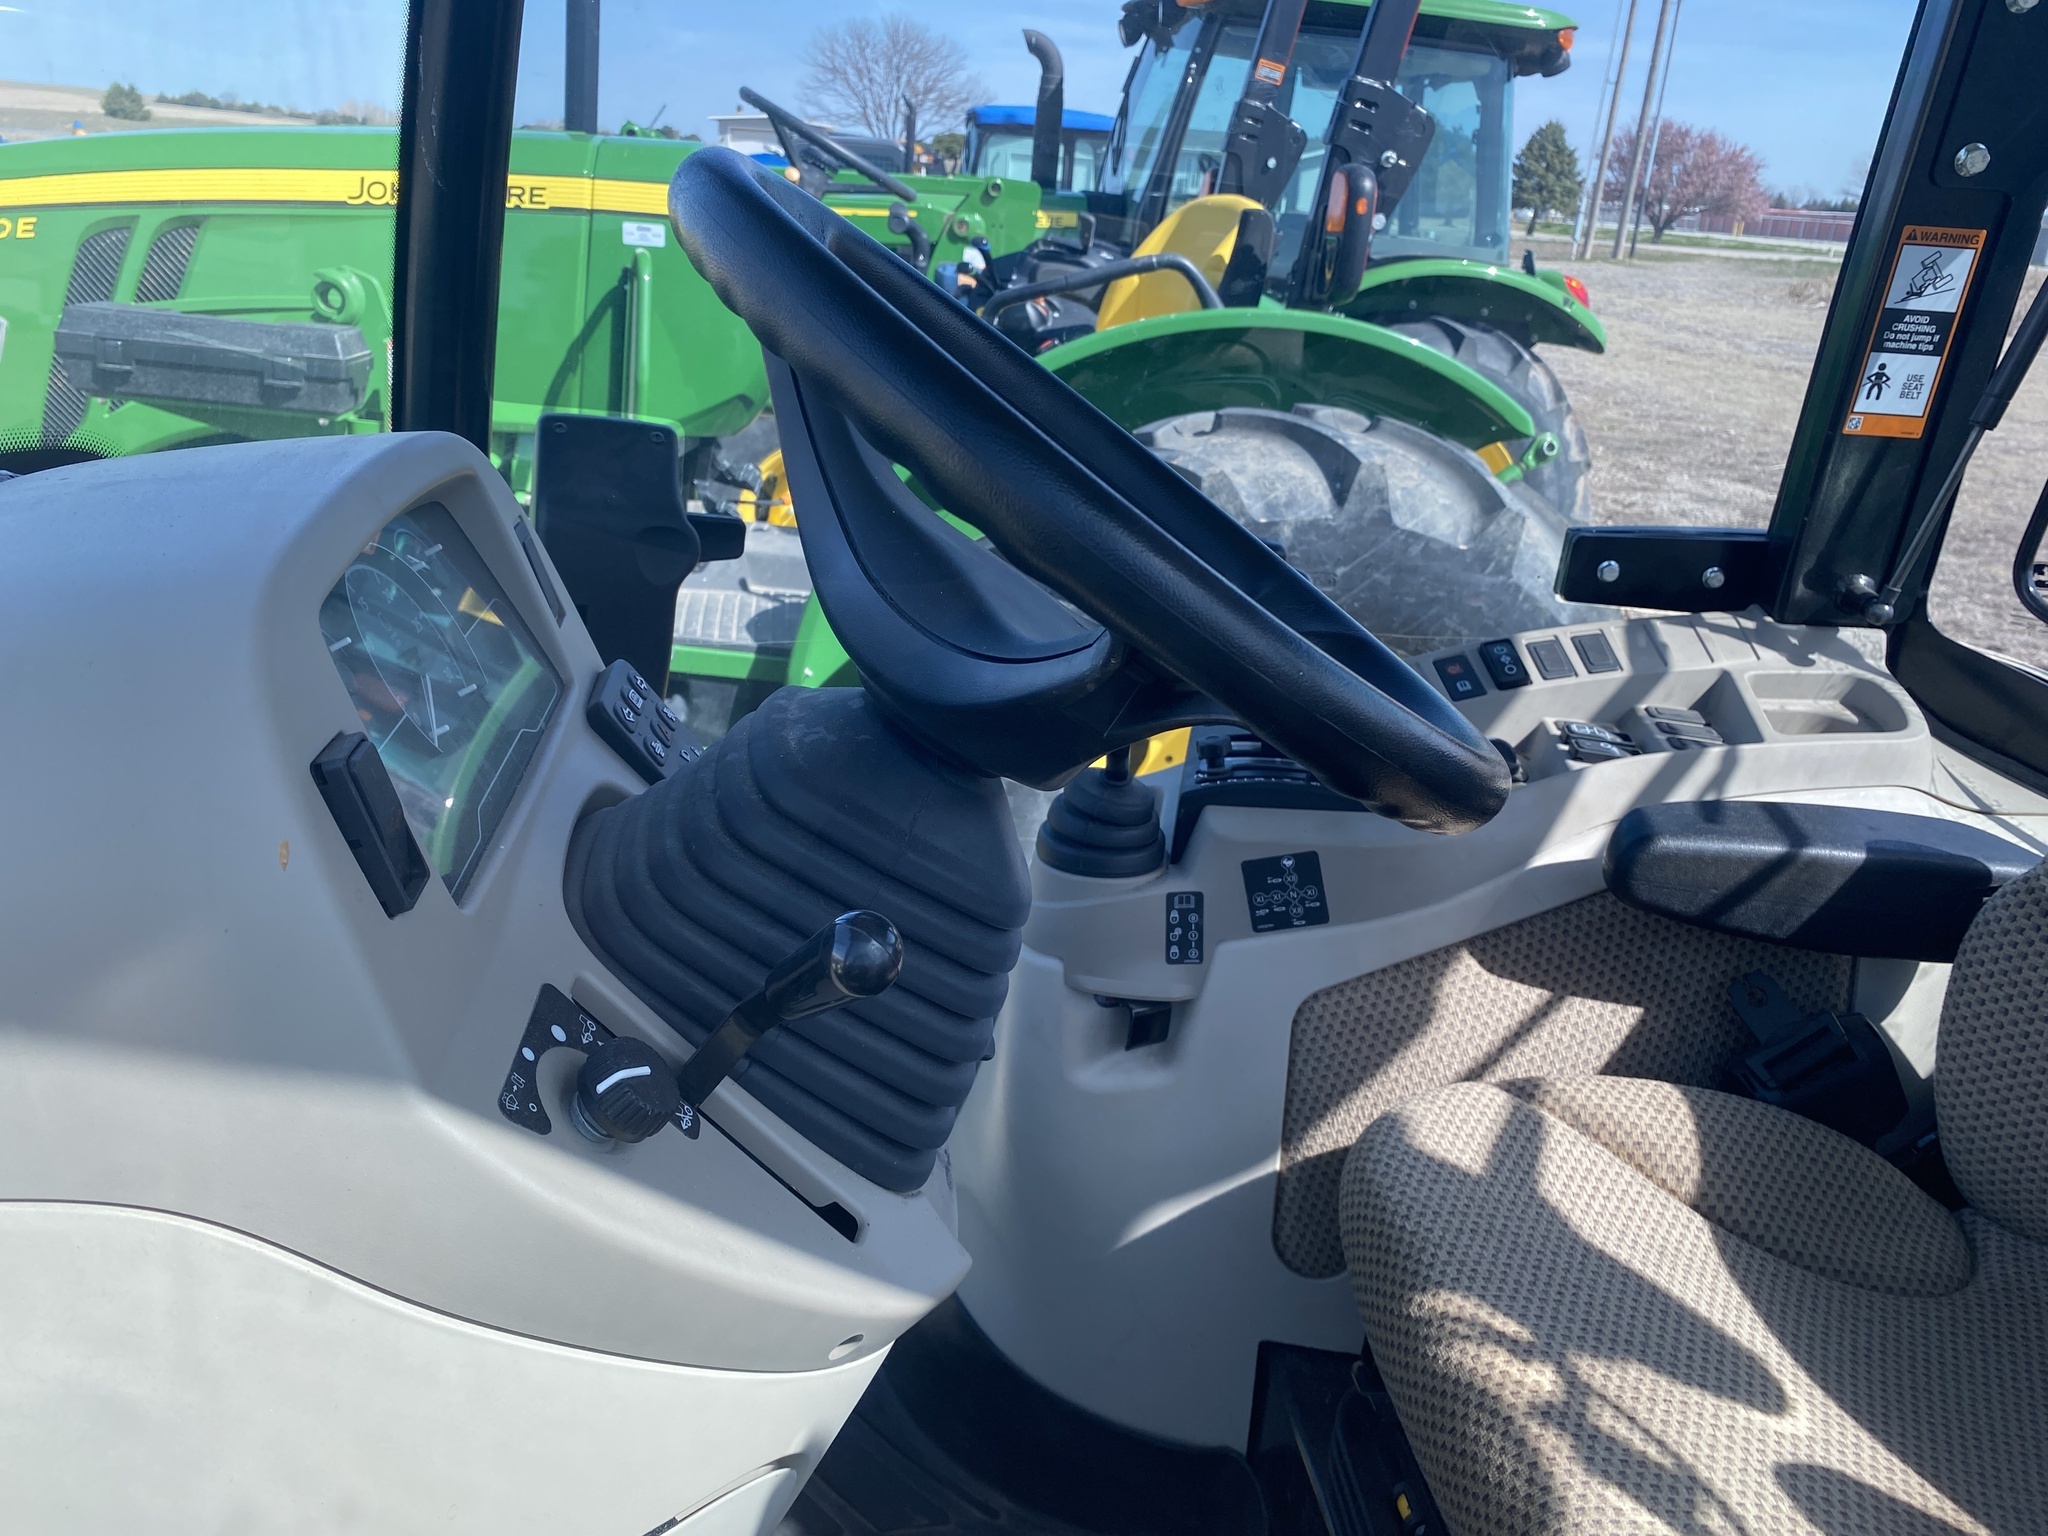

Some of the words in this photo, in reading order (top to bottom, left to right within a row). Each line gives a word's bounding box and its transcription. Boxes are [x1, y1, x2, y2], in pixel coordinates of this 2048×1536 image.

[1920, 231, 1980, 245] WARNING
[1903, 314, 1930, 324] AVOID
[1892, 323, 1937, 333] CRUSHING
[1883, 331, 1895, 340] Do
[1896, 333, 1910, 341] not
[1911, 333, 1932, 343] jump
[1933, 334, 1941, 343] if
[1883, 341, 1917, 350] machine
[1918, 343, 1934, 352] tips
[1906, 374, 1925, 383] USE
[1901, 382, 1925, 391] SEAT
[1899, 391, 1922, 400] BELT
